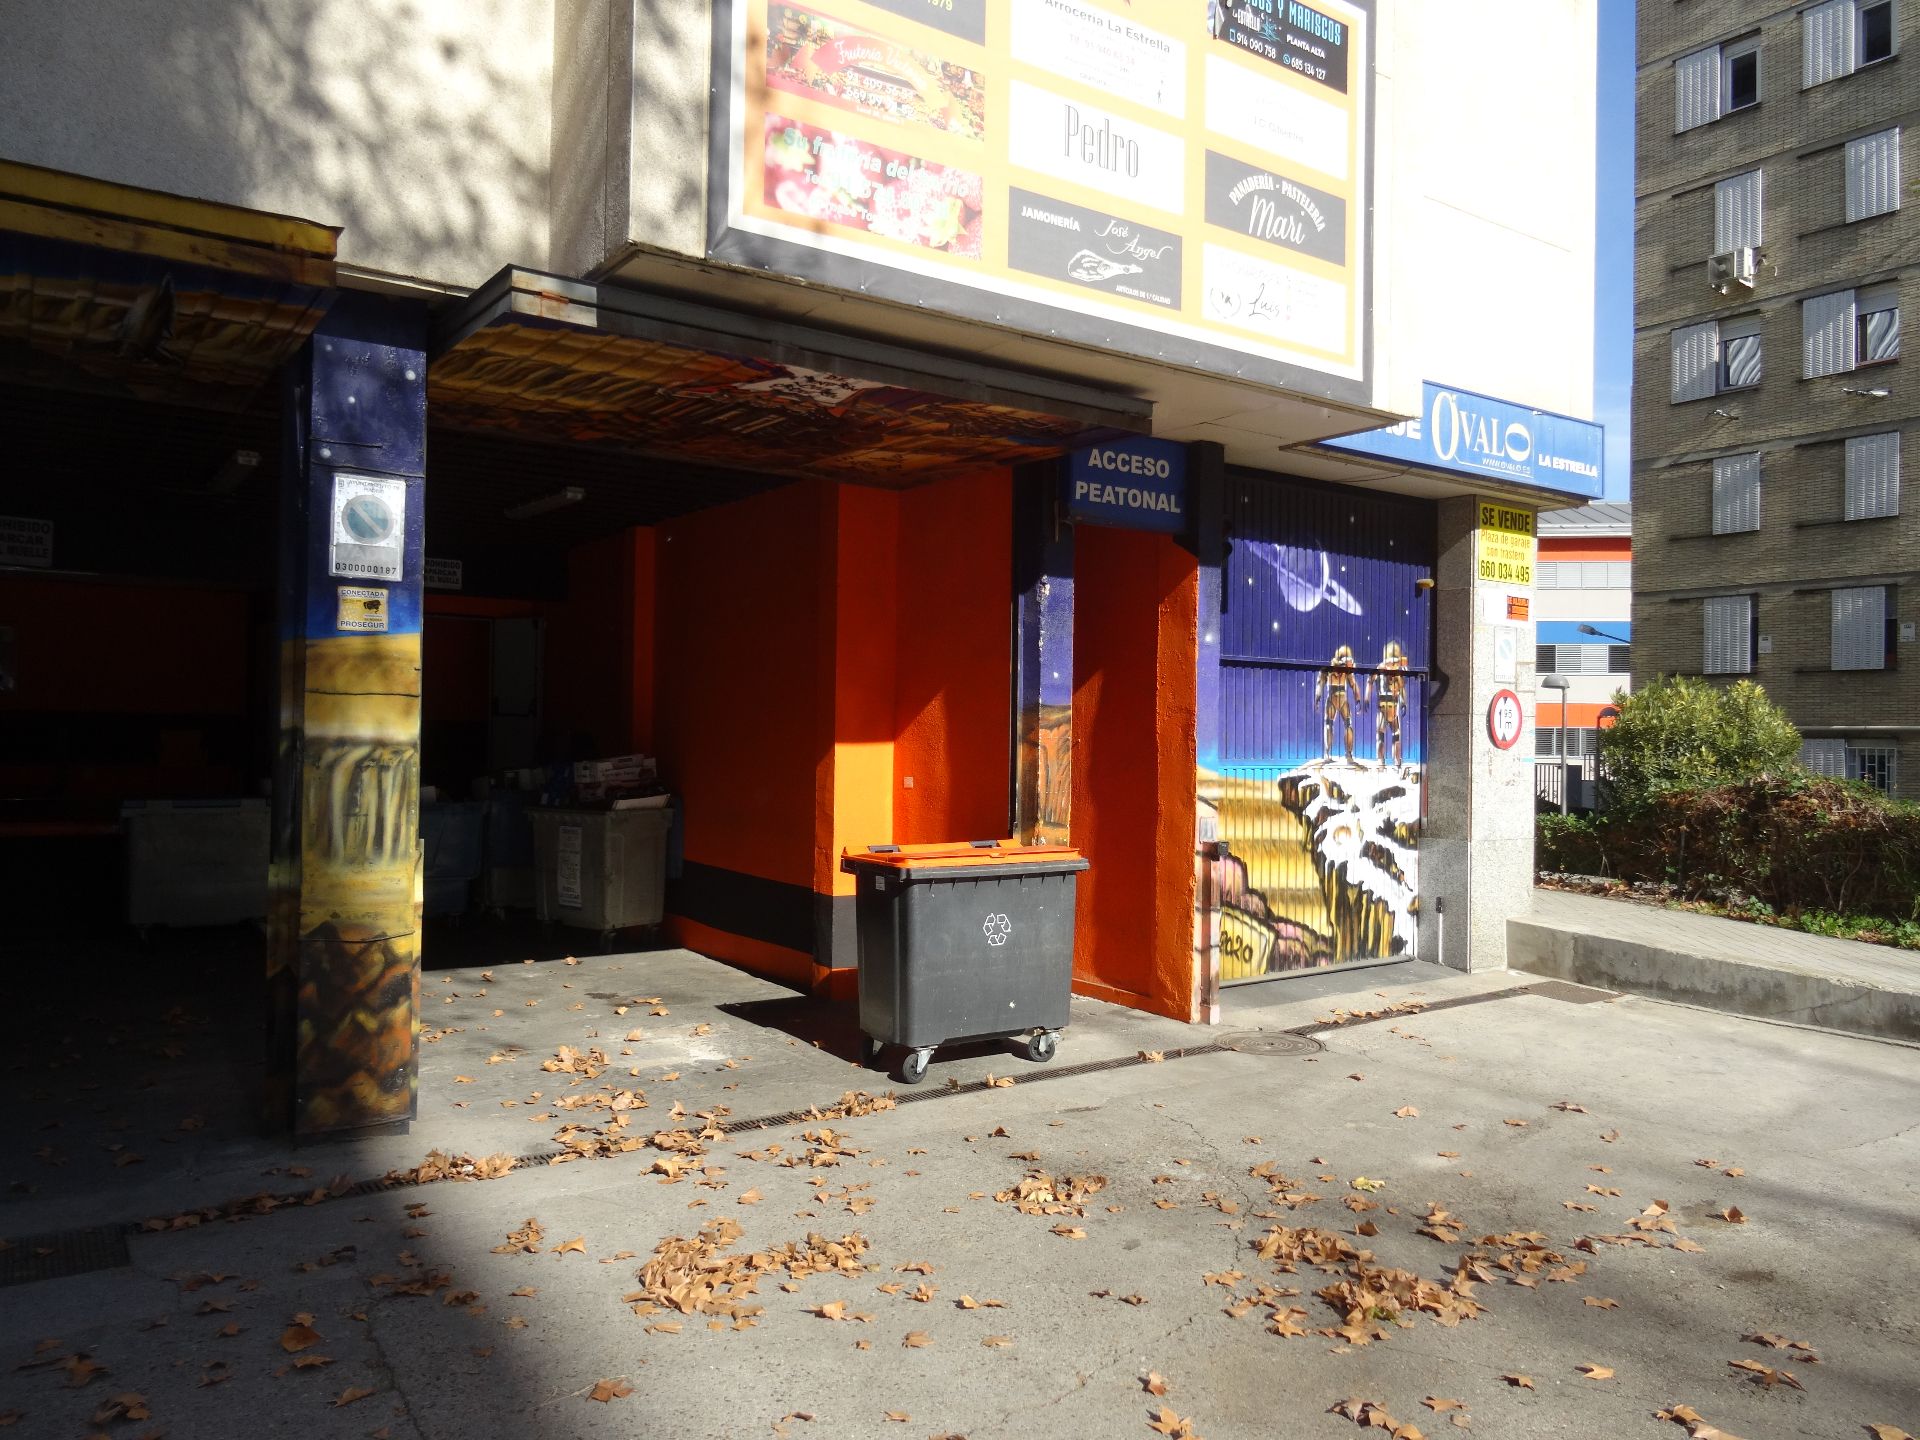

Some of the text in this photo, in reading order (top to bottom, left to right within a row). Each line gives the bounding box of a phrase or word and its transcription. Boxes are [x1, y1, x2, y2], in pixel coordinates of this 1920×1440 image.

[1237, 9, 1260, 33] ESTRELLA
[1289, 1, 1341, 46] MARISCOS
[1107, 19, 1122, 34] La
[1125, 27, 1171, 54] Estrella
[1236, 32, 1277, 60] 914 090 758
[1286, 34, 1326, 59] PLANTA ALTA
[1291, 56, 1326, 81] 685 134 127
[784, 127, 808, 150] Su
[1064, 104, 1139, 178] Pedro
[1228, 173, 1275, 206] PANADERÍA
[1281, 180, 1326, 233] PASTELERÍA
[1021, 205, 1081, 232] JAMONERÍA
[1094, 219, 1130, 237] José
[1248, 194, 1305, 245] Mari
[1152, 294, 1171, 305] CALIDAD
[1088, 448, 1170, 478] ACCESO
[1538, 453, 1598, 478] LA ESTRELLA
[1075, 480, 1181, 513] PEATONAL
[1481, 506, 1530, 533] SE VENDE
[1480, 529, 1531, 549] Plaza de garaje
[1486, 545, 1525, 562] con trastero
[335, 562, 397, 575] 0300000187
[1480, 560, 1530, 583] 660 034 495
[341, 589, 385, 597] CONECTADA
[340, 620, 385, 629] PROSEGUR
